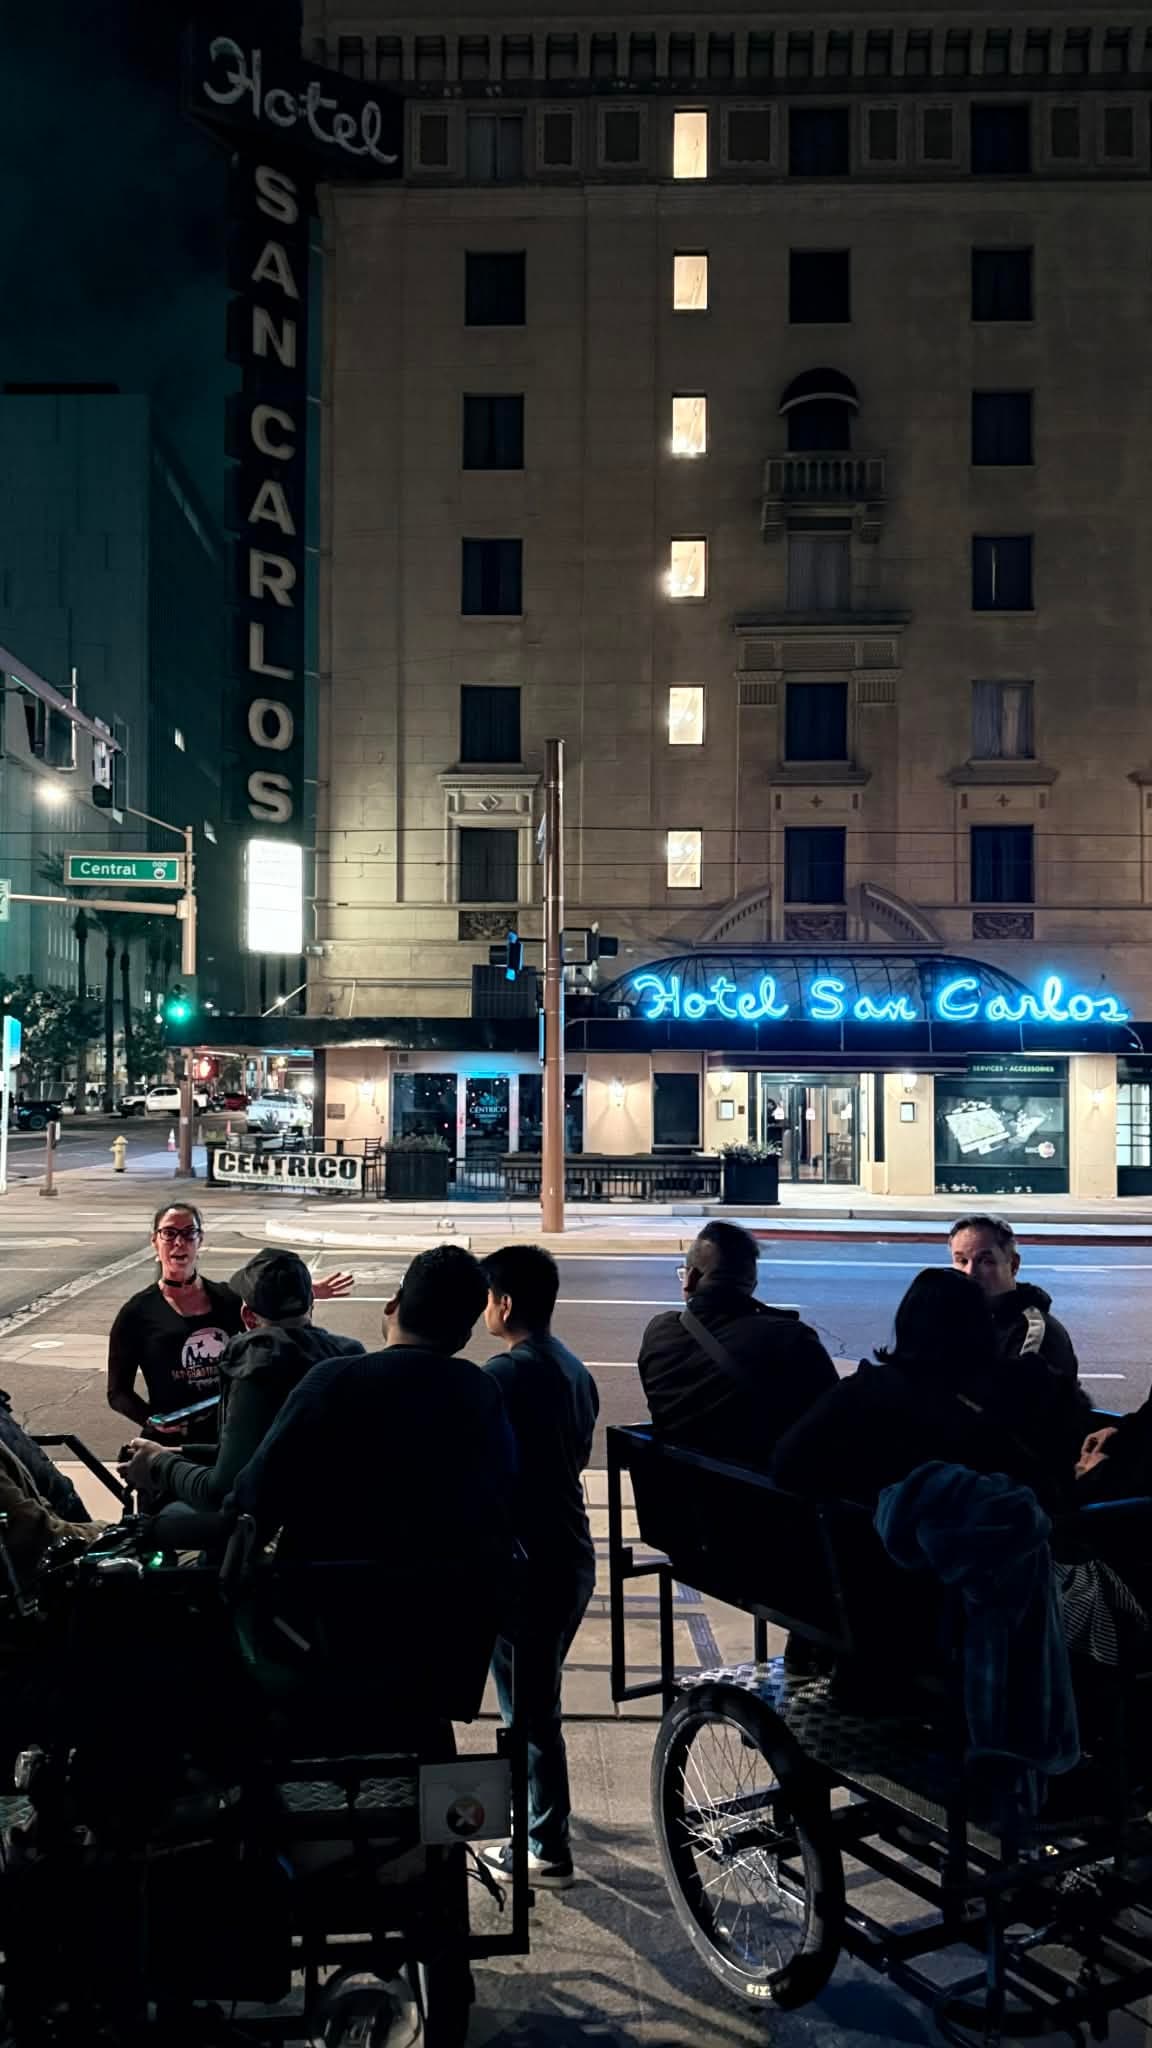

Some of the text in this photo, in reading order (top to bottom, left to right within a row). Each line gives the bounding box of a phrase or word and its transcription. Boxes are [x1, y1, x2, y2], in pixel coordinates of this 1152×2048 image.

[203, 36, 398, 164] Hotel
[80, 861, 137, 876] Central
[633, 974, 1130, 1022] Hotel San Carlos
[218, 1152, 358, 1180] CENTRICO
